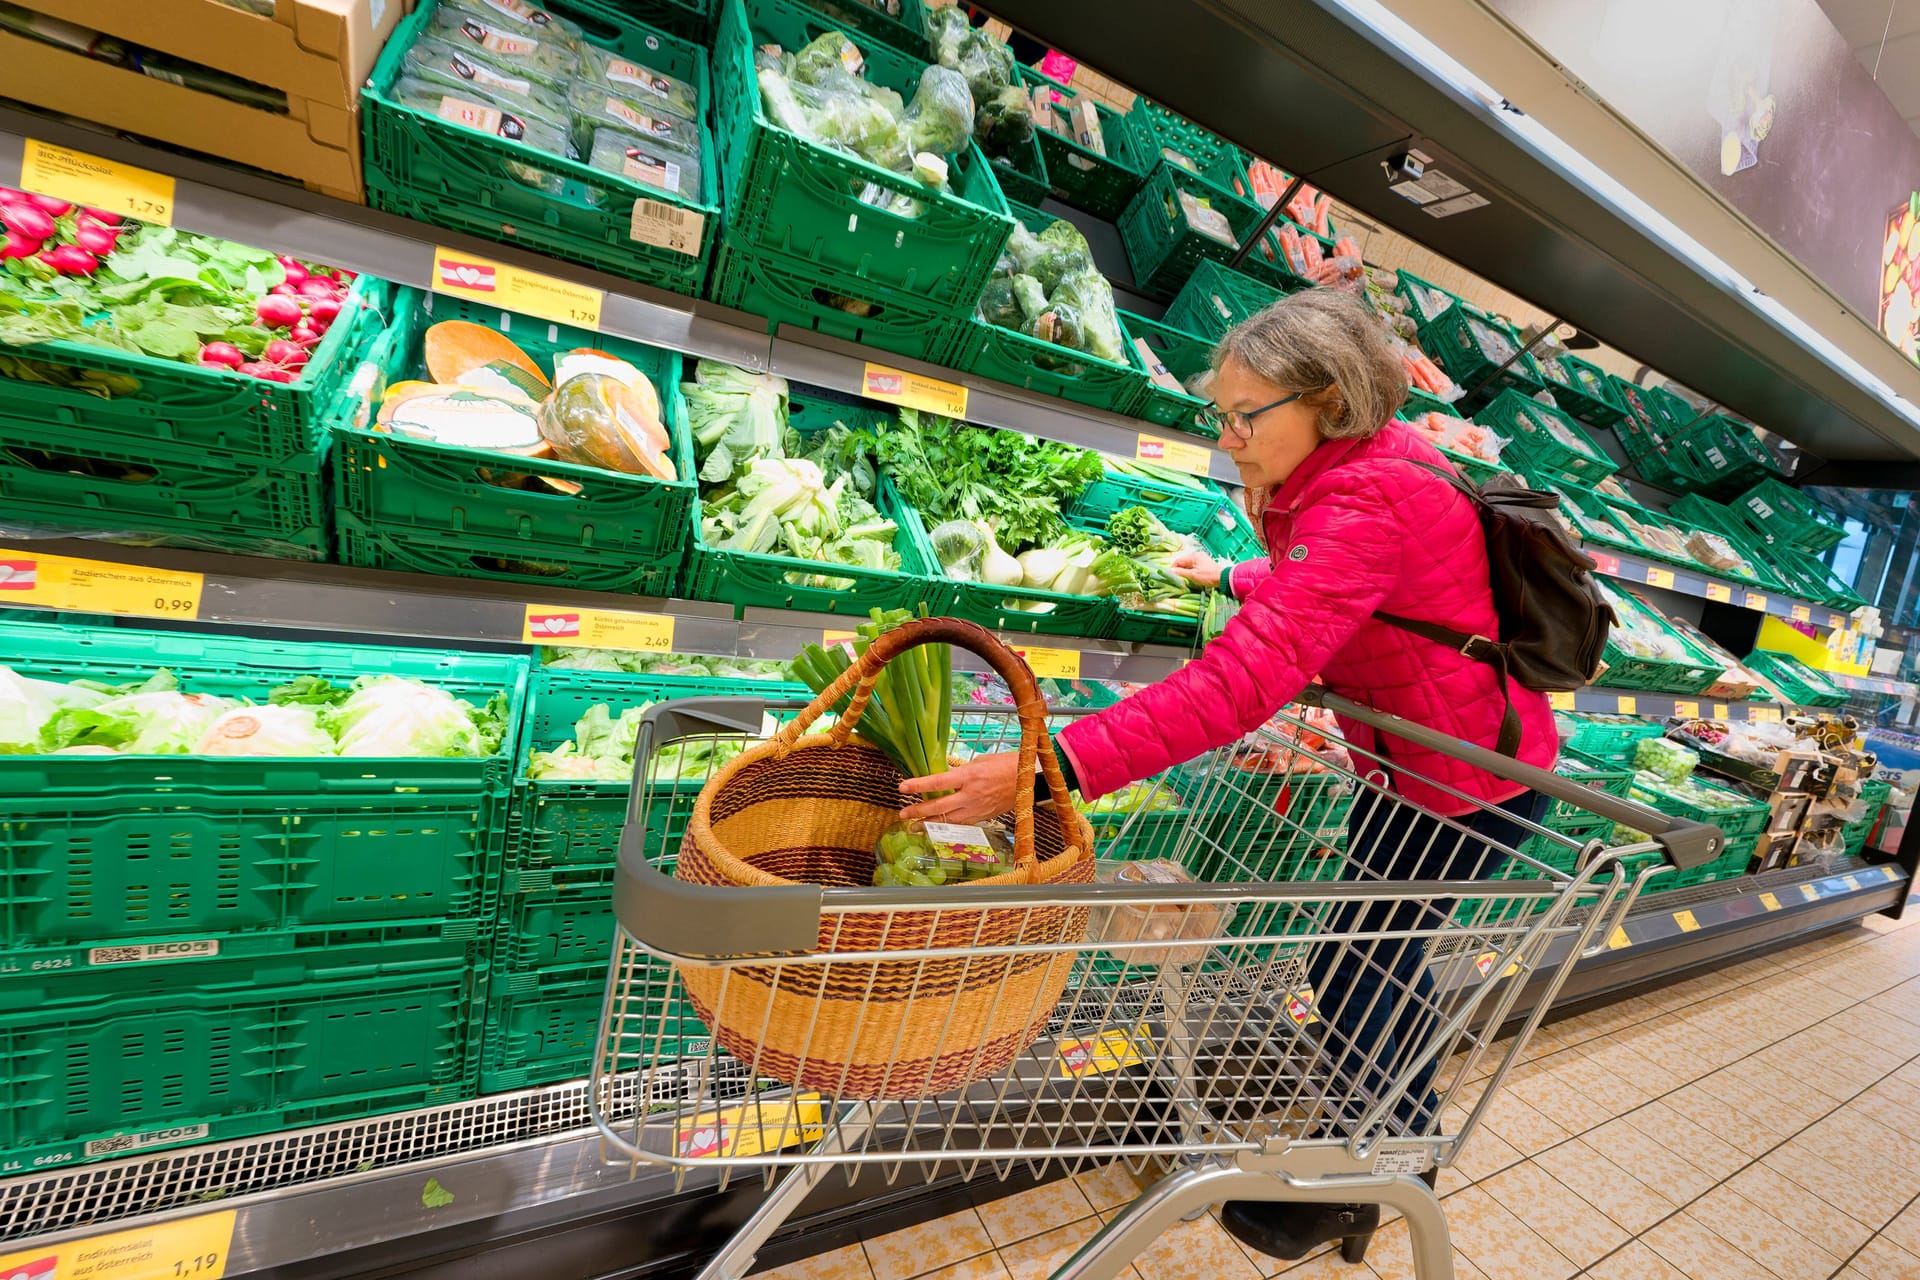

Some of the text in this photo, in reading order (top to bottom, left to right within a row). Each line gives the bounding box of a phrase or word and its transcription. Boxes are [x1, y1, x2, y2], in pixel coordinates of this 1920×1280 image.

[127, 197, 166, 216] 1,79
[569, 309, 596, 323] 1,79
[948, 403, 964, 413] 1,49
[128, 575, 145, 583] aus
[154, 597, 193, 612] 0,99
[644, 636, 669, 648] 2,49
[1061, 665, 1076, 673] 2,29
[147, 942, 192, 955] IFCO
[31, 958, 73, 970] 6424
[140, 1128, 182, 1142] IFCO
[3, 1152, 73, 1171] LL 6424
[72, 1264, 94, 1277] aus
[173, 1252, 218, 1279] 1,19
